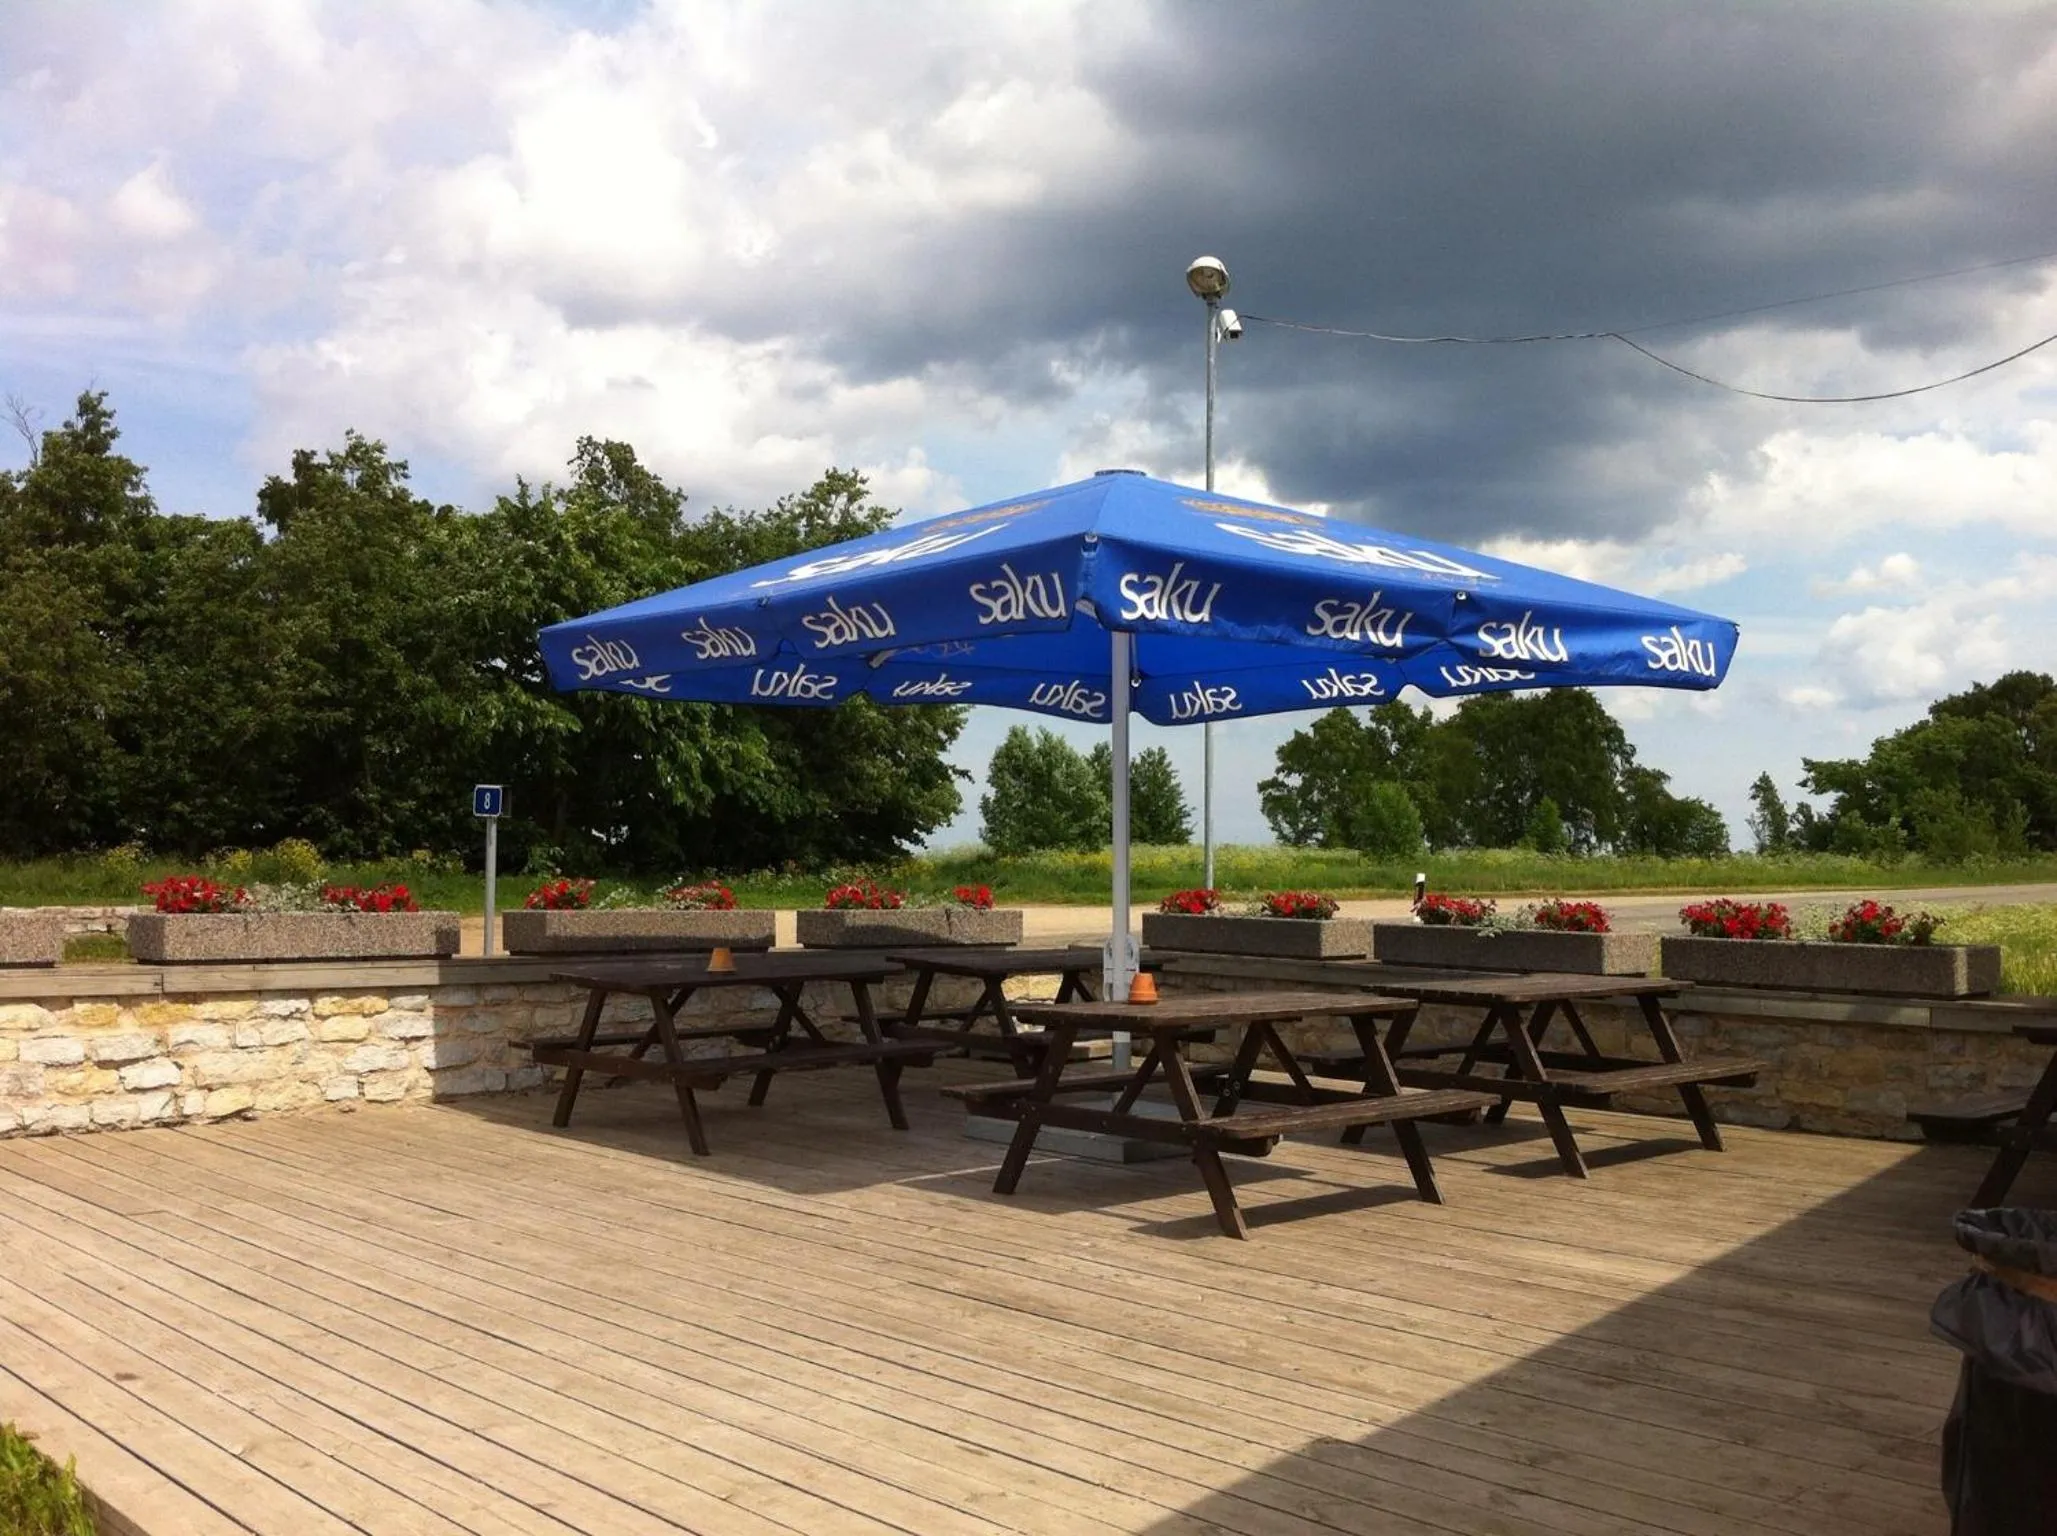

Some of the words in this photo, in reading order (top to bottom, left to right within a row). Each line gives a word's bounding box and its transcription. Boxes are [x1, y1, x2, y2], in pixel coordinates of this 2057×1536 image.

[969, 563, 1067, 626] saku
[1120, 562, 1221, 625] saku
[681, 616, 757, 660] saku
[802, 597, 896, 650] saku
[1307, 591, 1412, 649] saku
[1478, 610, 1569, 662] saku
[572, 634, 640, 681] saku
[1641, 625, 1717, 677] saku
[483, 792, 491, 810] 8
